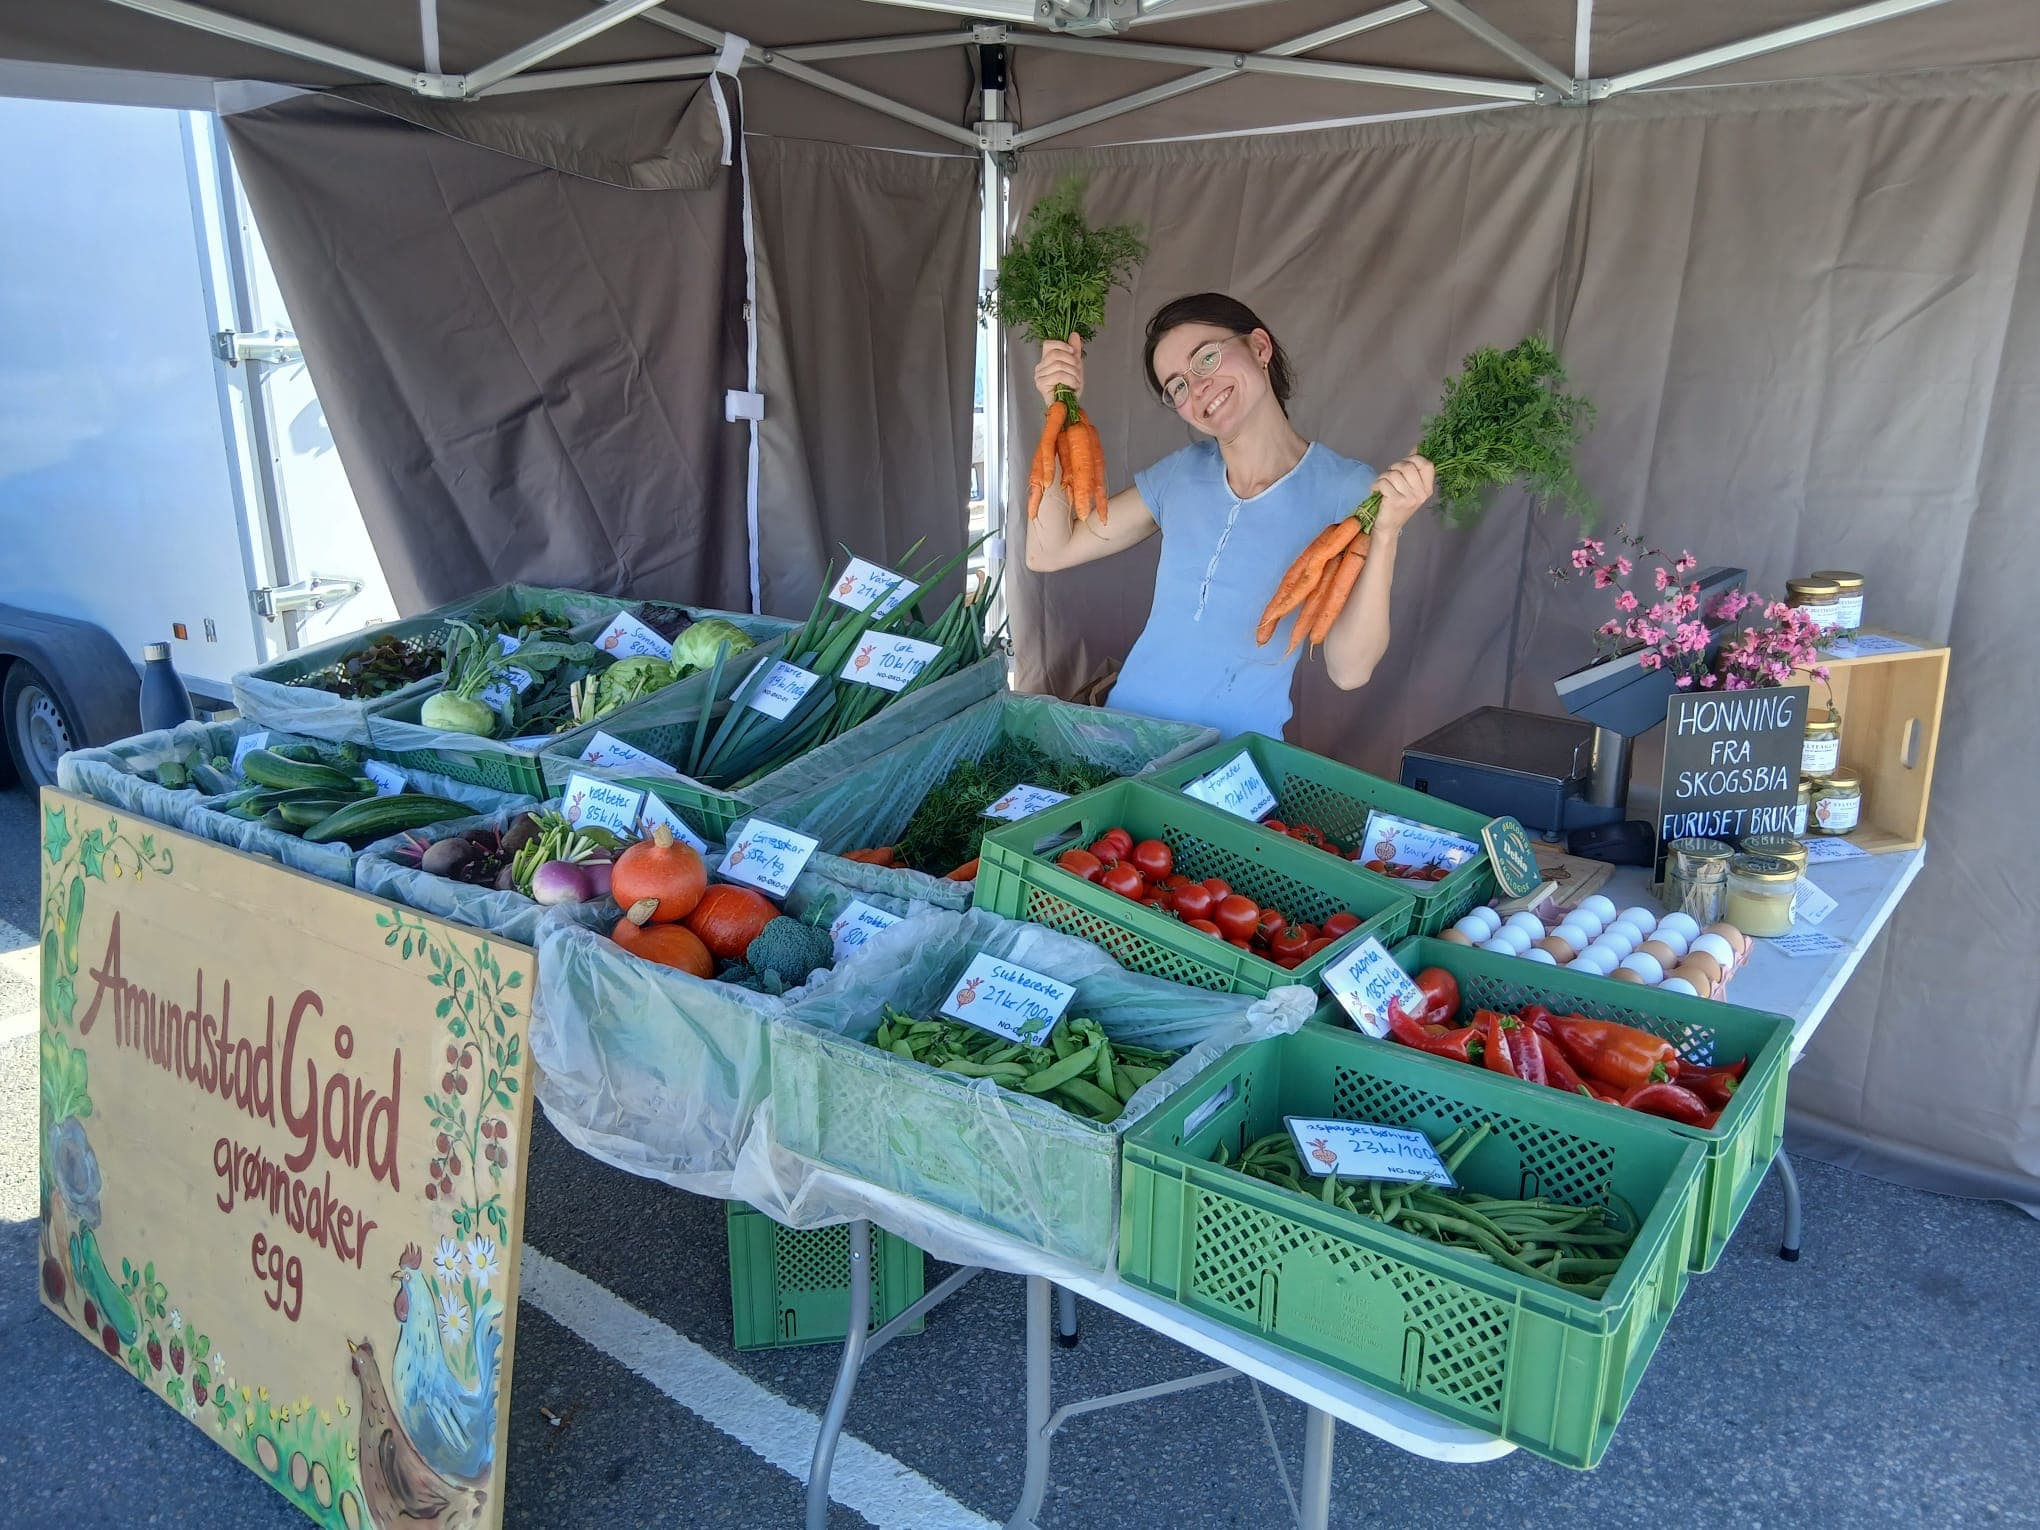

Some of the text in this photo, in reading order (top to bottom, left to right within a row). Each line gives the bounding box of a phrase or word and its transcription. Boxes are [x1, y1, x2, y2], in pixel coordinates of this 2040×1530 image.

[1678, 695, 1796, 736] HONNING
[1710, 739, 1751, 766] FRA
[589, 785, 631, 808] rødbeter
[1675, 766, 1788, 798] SKOGSBIA
[1662, 808, 1748, 841] FURUSET
[1750, 804, 1797, 836] BRUK
[1503, 839, 1528, 873] Debio
[991, 965, 1065, 1001] Sukkererter
[1349, 950, 1382, 983] paprika
[80, 910, 402, 1193] Amundstad Gård
[213, 1137, 379, 1269] grønnsaker
[251, 1232, 304, 1322] egg
